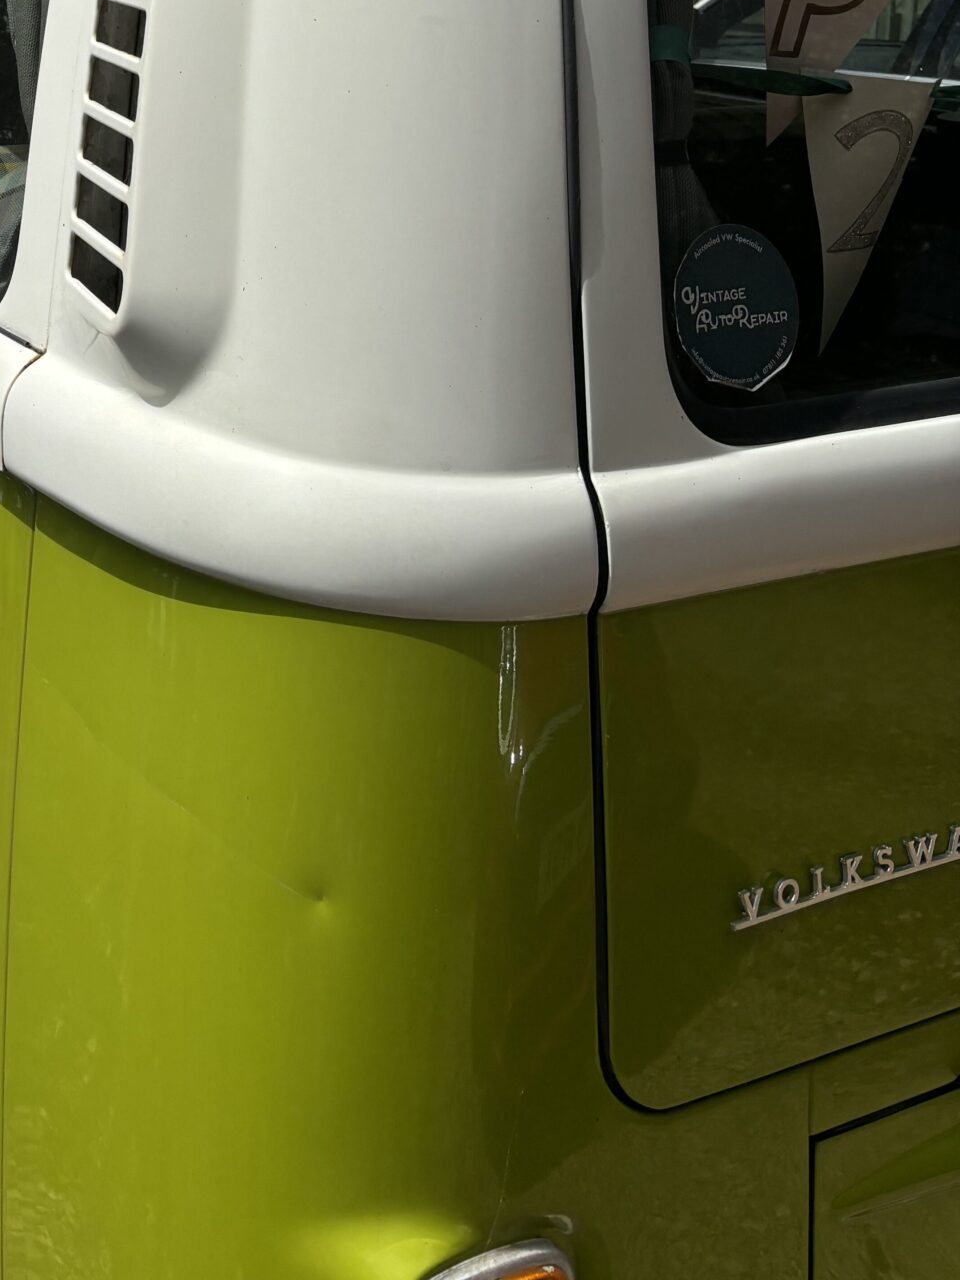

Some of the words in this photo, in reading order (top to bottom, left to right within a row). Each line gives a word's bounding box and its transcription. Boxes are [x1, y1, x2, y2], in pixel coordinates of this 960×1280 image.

[827, 109, 914, 254] 2
[693, 233, 721, 260] Aircooled
[720, 233, 734, 241] VW
[735, 233, 763, 253] Specialist
